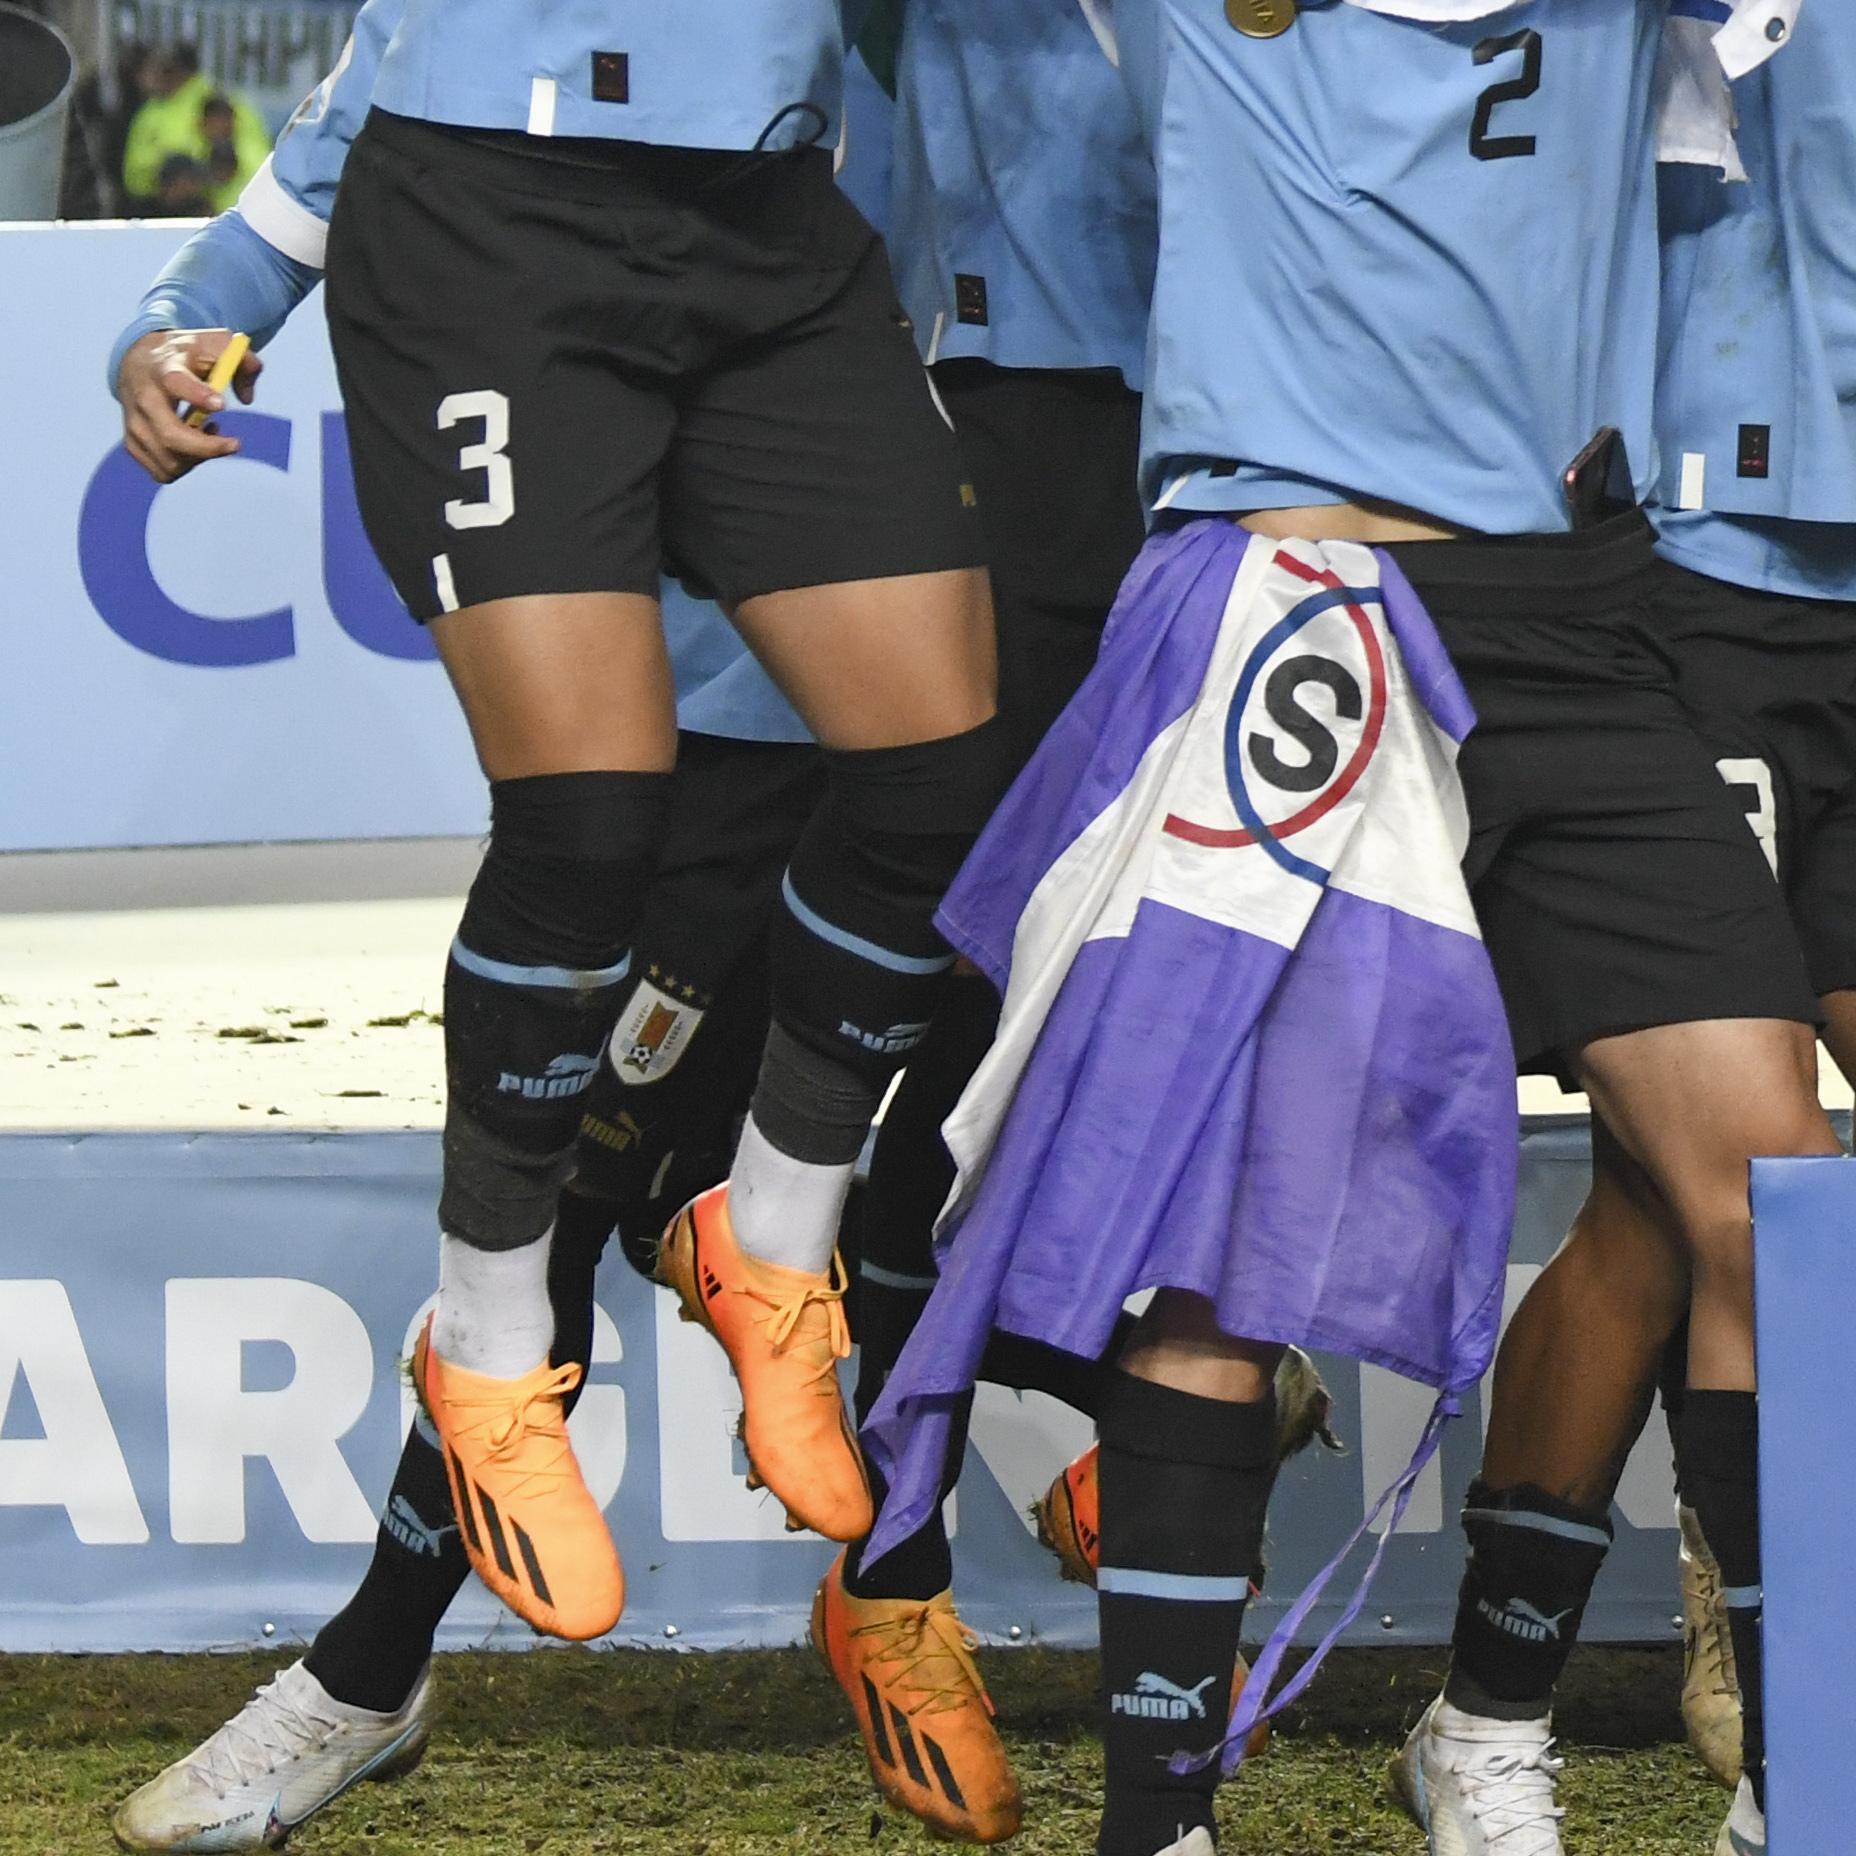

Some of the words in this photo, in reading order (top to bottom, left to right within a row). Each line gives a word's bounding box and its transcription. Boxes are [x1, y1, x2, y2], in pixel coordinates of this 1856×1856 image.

[1470, 27, 1543, 162] 2
[436, 390, 516, 531] 3
[1247, 654, 1362, 793] S
[1476, 1597, 1547, 1642] PUMA
[1111, 1693, 1190, 1721] PUMA
